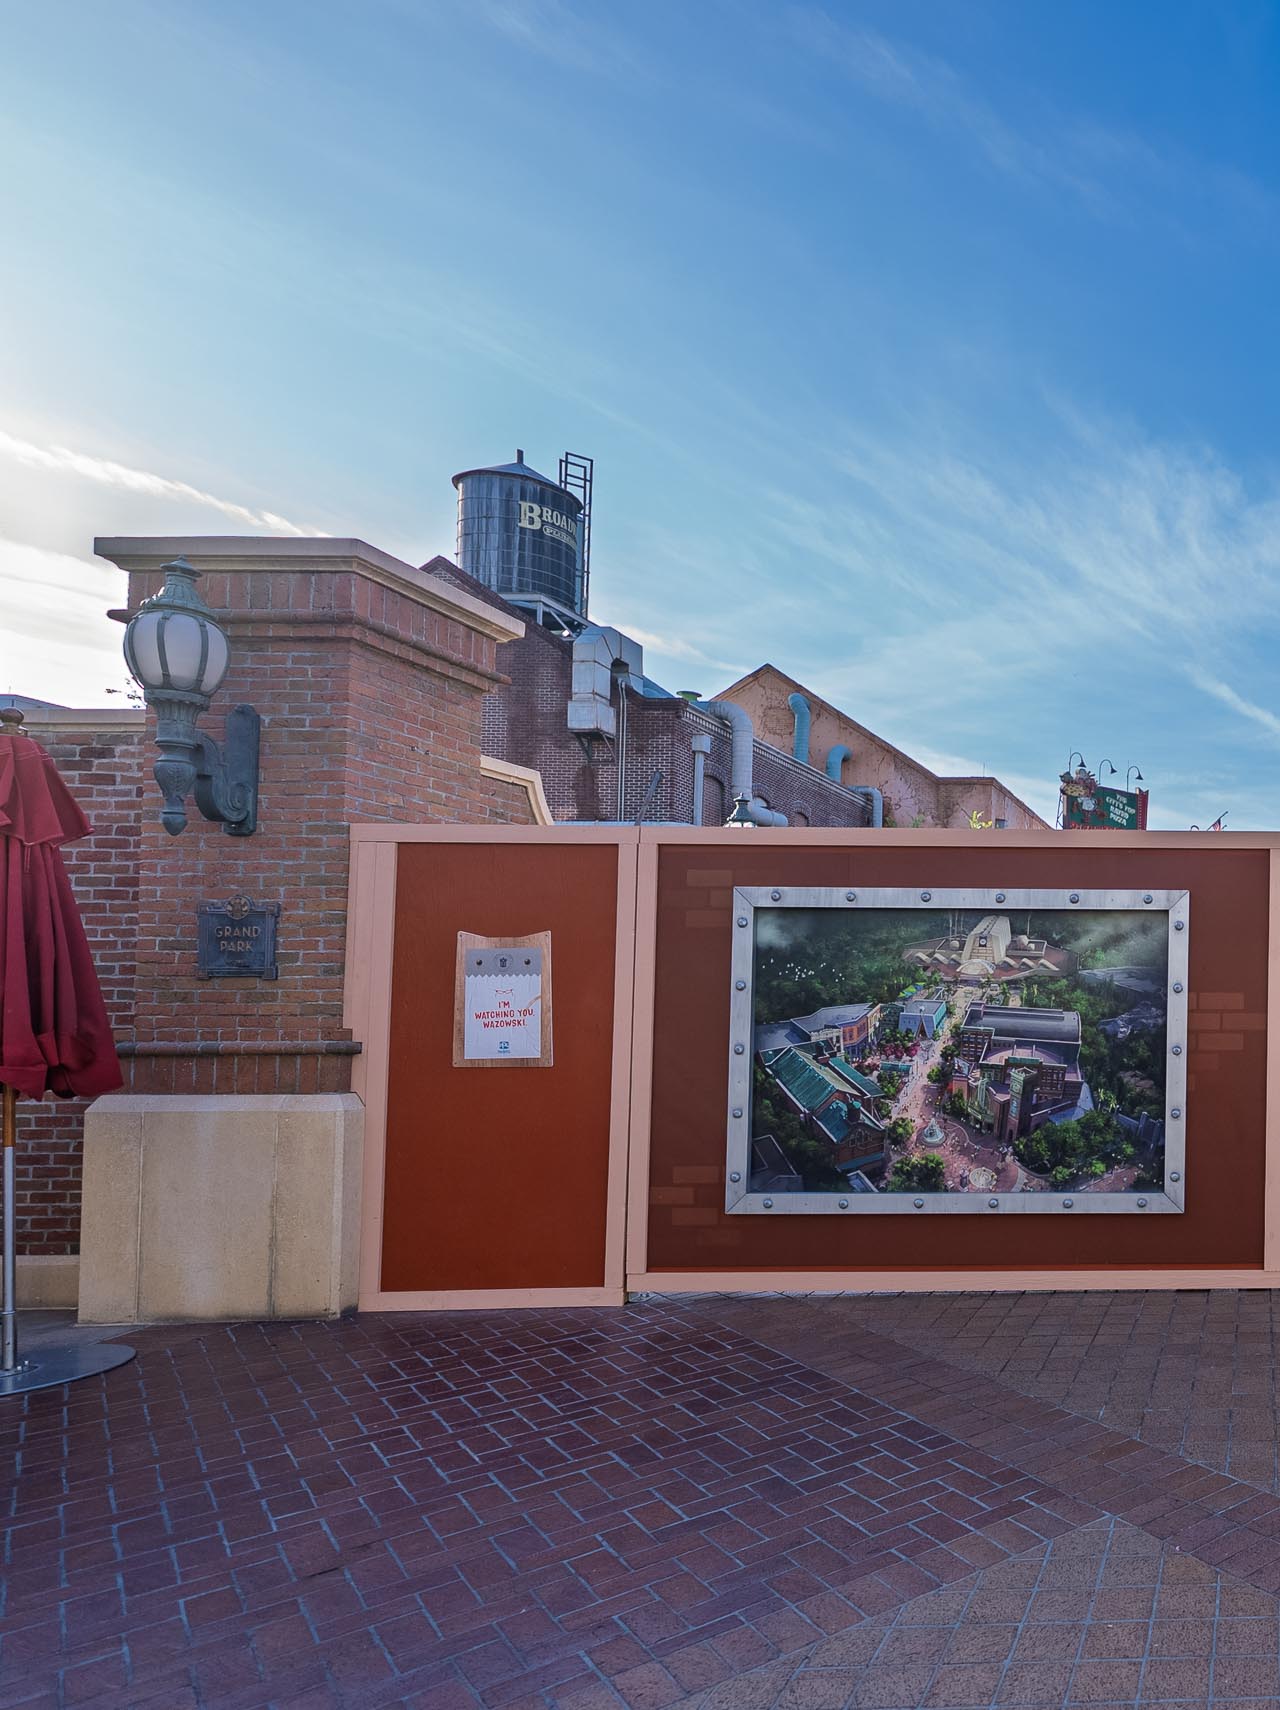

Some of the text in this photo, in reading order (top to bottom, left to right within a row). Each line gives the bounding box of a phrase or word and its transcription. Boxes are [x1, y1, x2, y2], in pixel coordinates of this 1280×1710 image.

[215, 926, 261, 938] GRAND
[220, 940, 254, 952] PARK
[475, 1009, 515, 1020] WATCHING
